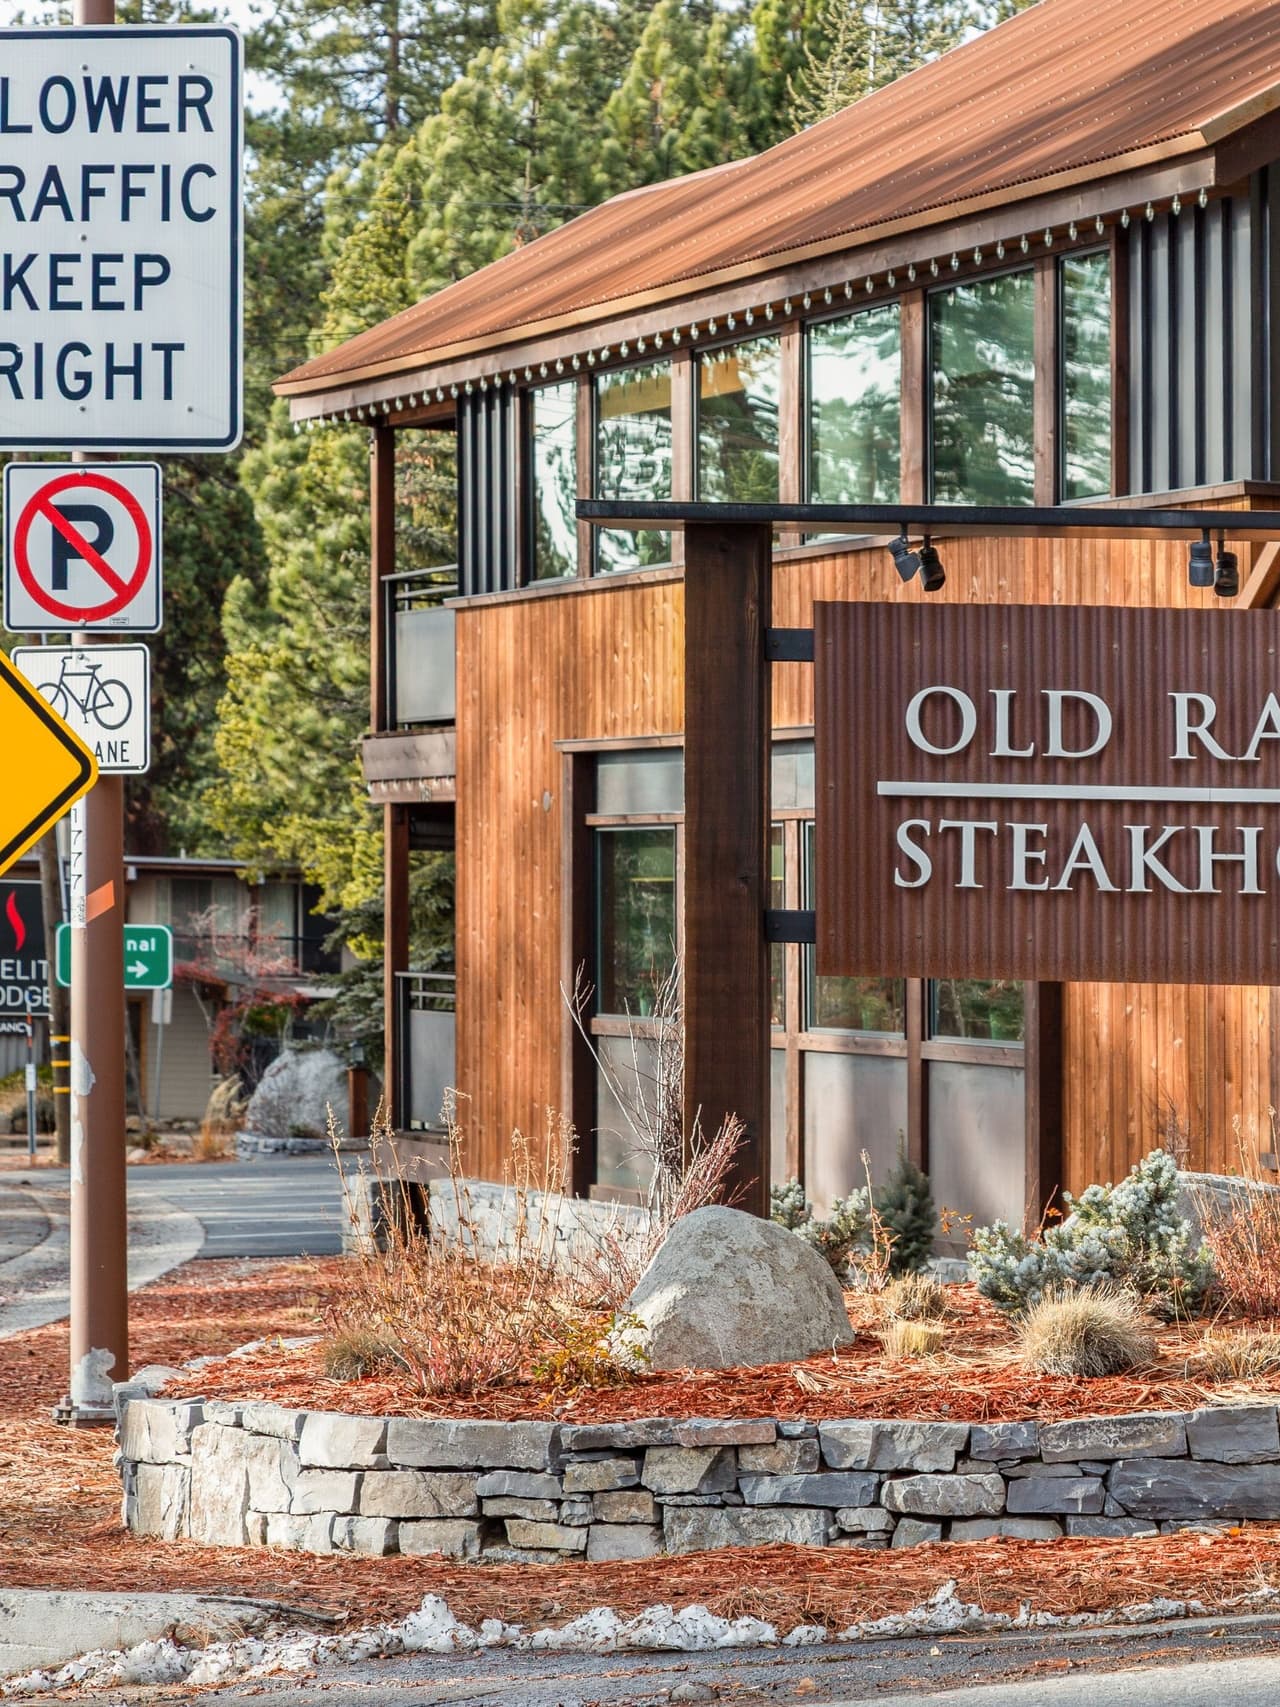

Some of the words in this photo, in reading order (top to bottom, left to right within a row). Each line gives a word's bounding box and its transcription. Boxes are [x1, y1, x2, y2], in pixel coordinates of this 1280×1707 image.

[0, 75, 215, 134] LOWER
[0, 163, 218, 223] RAFFIC
[3, 253, 172, 312] KEEP
[0, 341, 186, 401] RIGHT
[95, 740, 130, 763] ANE
[904, 685, 1113, 759] OLD
[126, 937, 156, 952] nal
